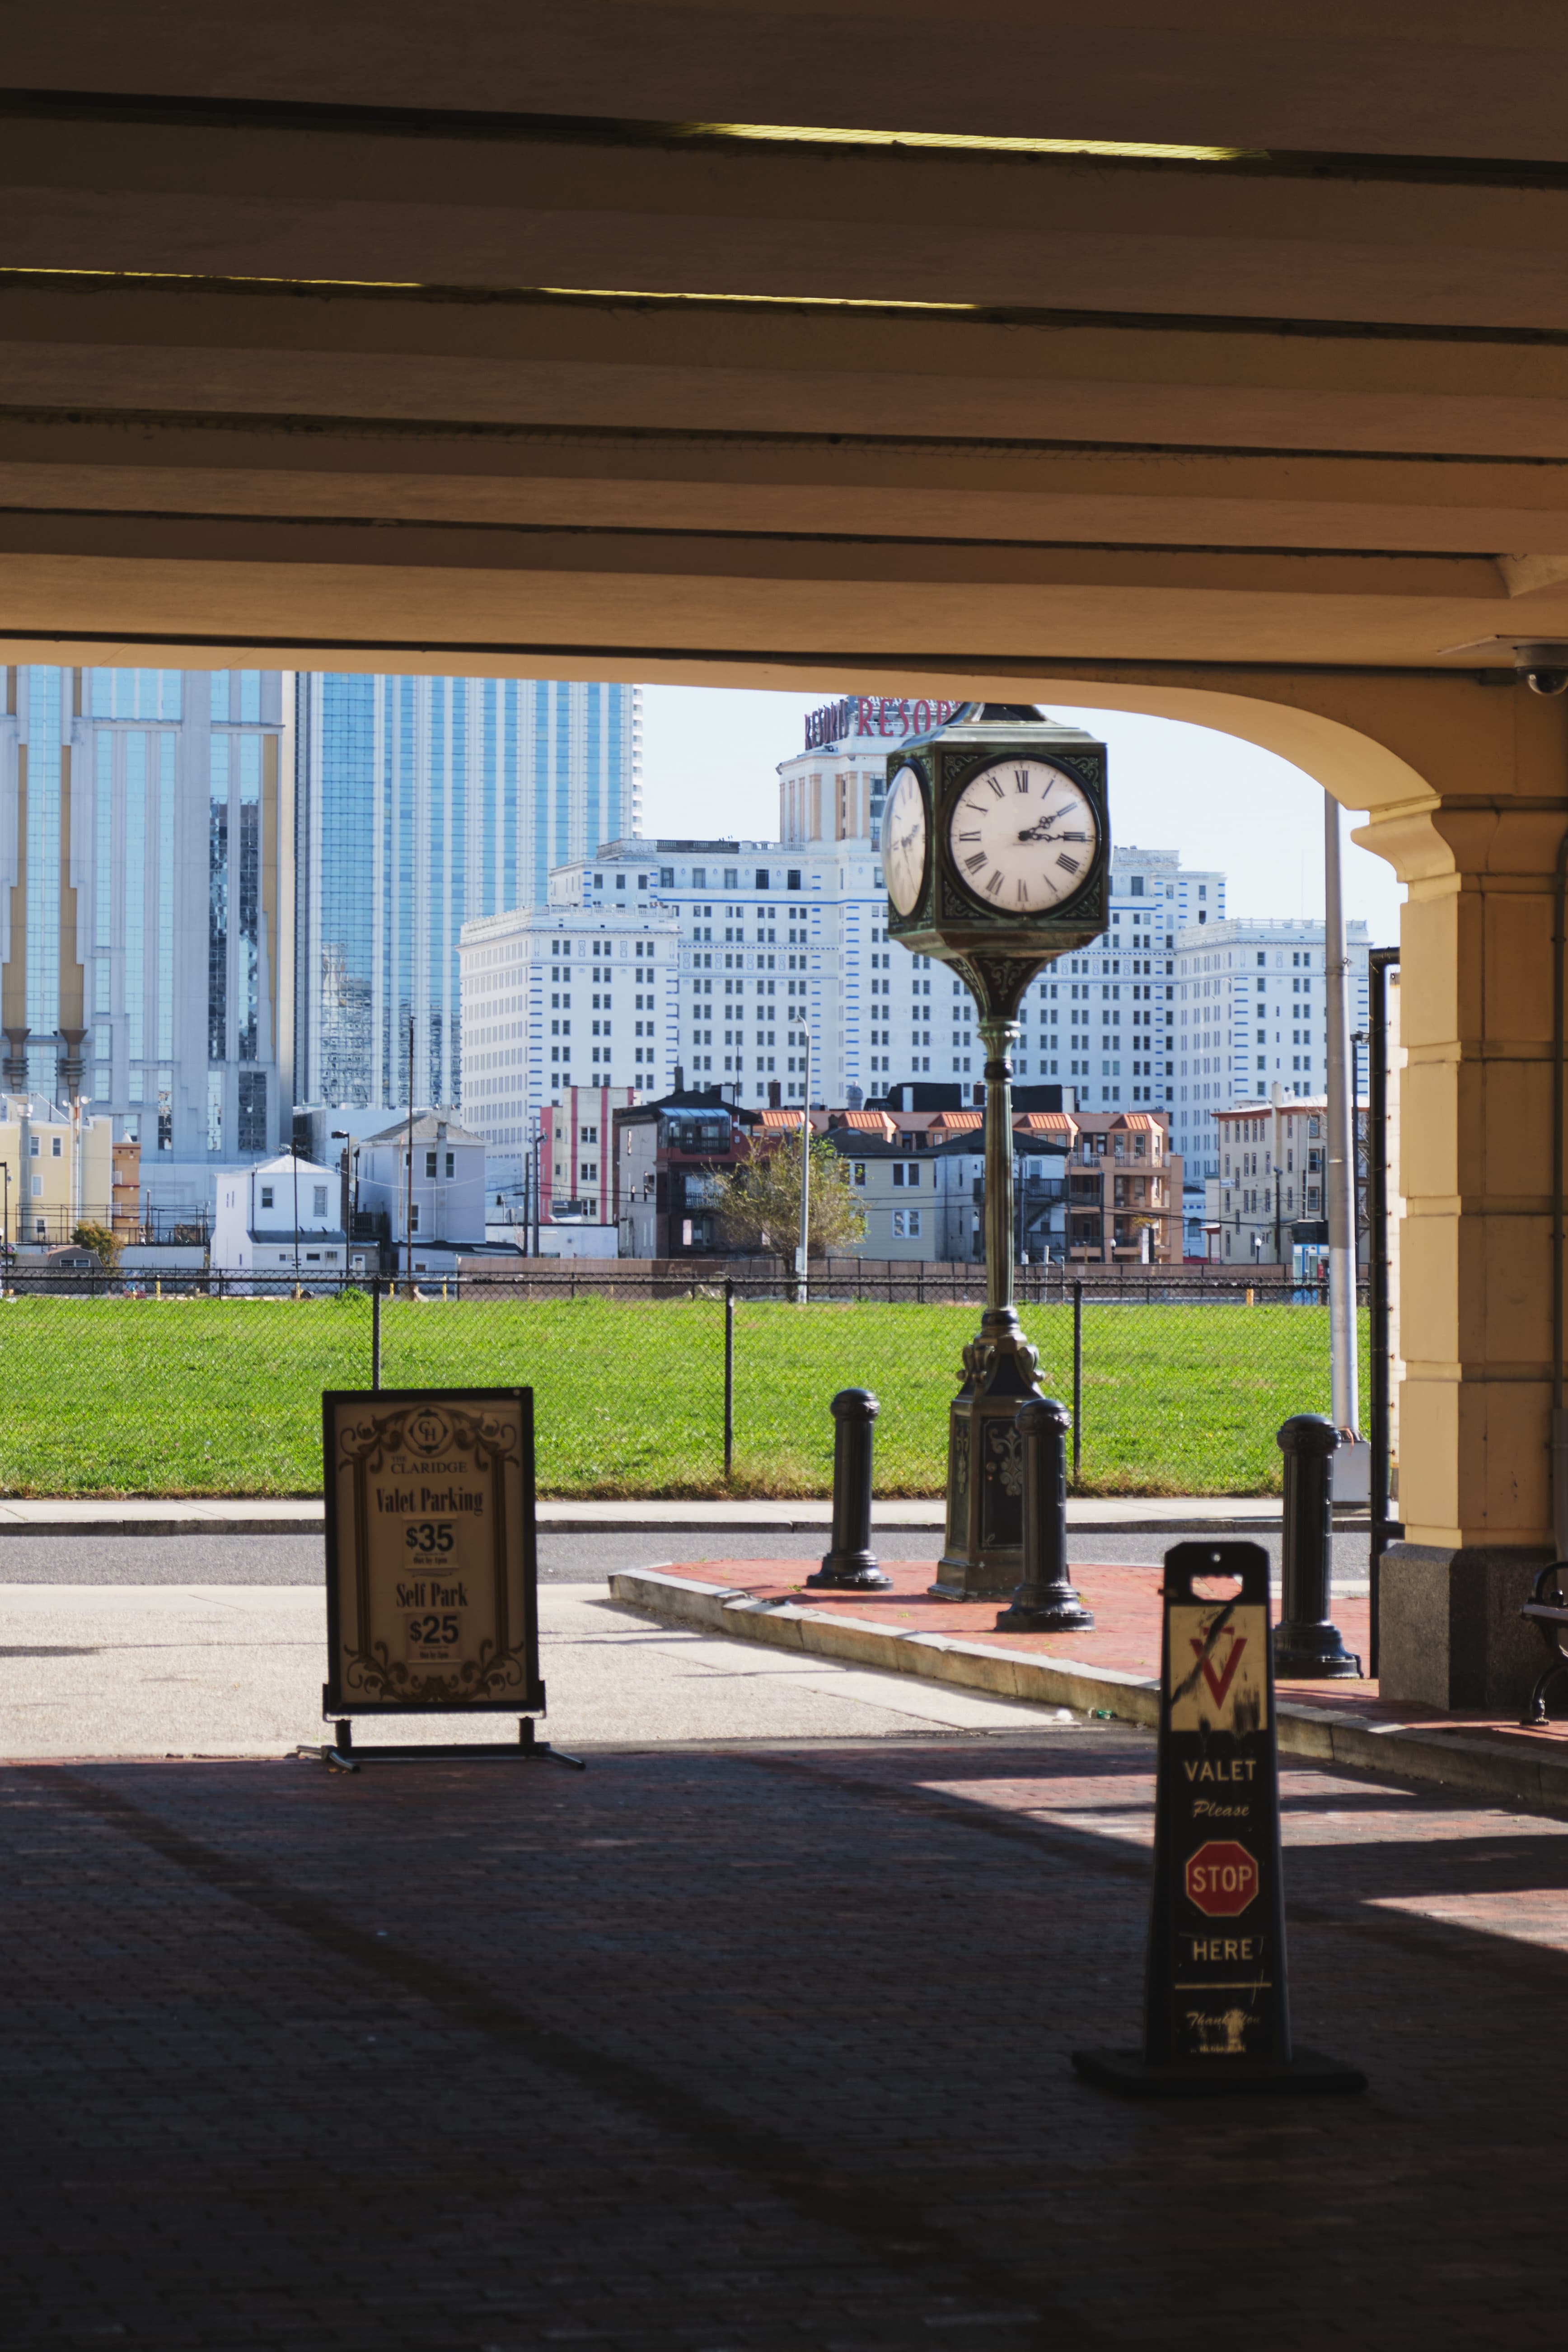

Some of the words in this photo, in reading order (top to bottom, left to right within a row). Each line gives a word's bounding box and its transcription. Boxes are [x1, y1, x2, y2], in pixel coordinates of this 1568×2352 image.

[857, 698, 961, 737] RESOR
[987, 776, 1006, 800] XI
[1015, 769, 1029, 794] XII
[1042, 778, 1055, 800] I
[1057, 801, 1078, 817] II
[964, 851, 989, 875] VIII
[1056, 852, 1081, 875] IIII
[1018, 879, 1029, 902] VI
[391, 1462, 468, 1474] CLARIDGE
[376, 1488, 415, 1513] Valet
[421, 1487, 483, 1517] Parking
[406, 1523, 454, 1552] $35
[396, 1582, 426, 1608] Self
[431, 1581, 468, 1607] Park
[410, 1614, 459, 1644] $25
[1183, 1759, 1257, 1782] VALET
[1192, 1800, 1250, 1818] Please
[1192, 1866, 1253, 1893] STOP
[1193, 1938, 1254, 1961] HERE
